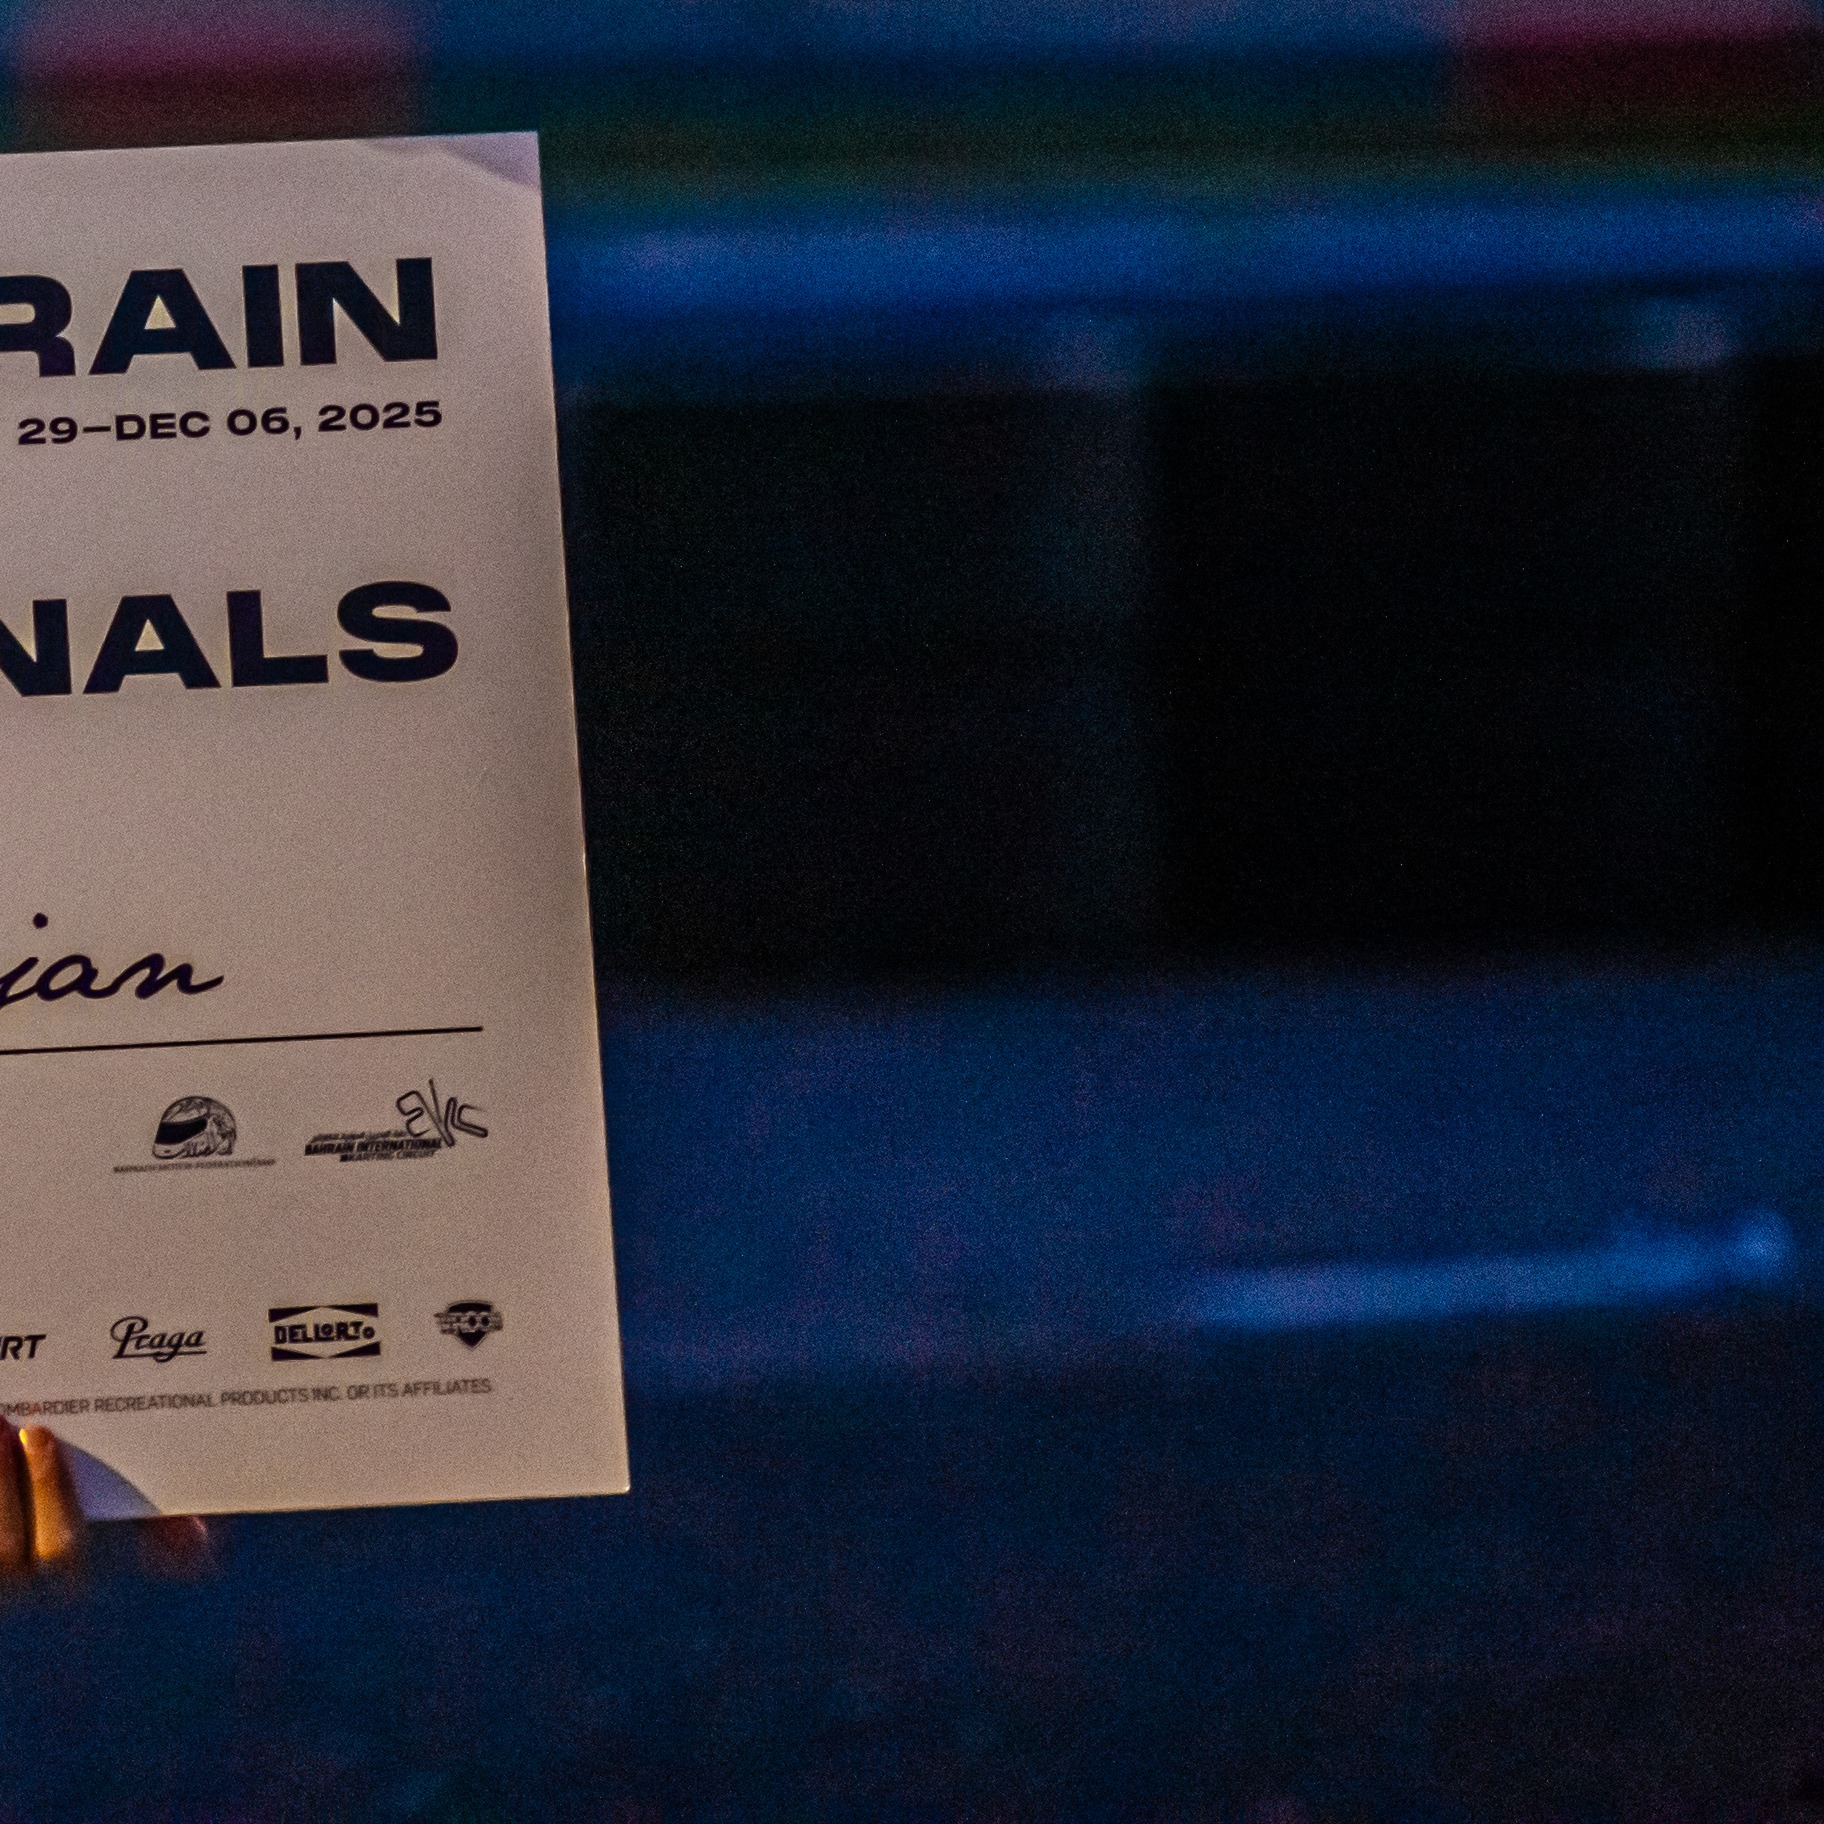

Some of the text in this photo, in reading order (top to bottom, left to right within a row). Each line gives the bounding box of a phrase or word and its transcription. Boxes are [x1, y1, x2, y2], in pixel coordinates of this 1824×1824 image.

[226, 406, 302, 440] 06,
[318, 400, 443, 432] 2025
[304, 1141, 354, 1156] BAHRAIN
[356, 1137, 443, 1153] INTERNATIONAL
[110, 1315, 207, 1364] Praga
[94, 1392, 215, 1414] RECREATIONAL
[221, 1387, 309, 1406] PRODUCTS
[347, 1383, 370, 1401] OR
[373, 1381, 400, 1399] ITS
